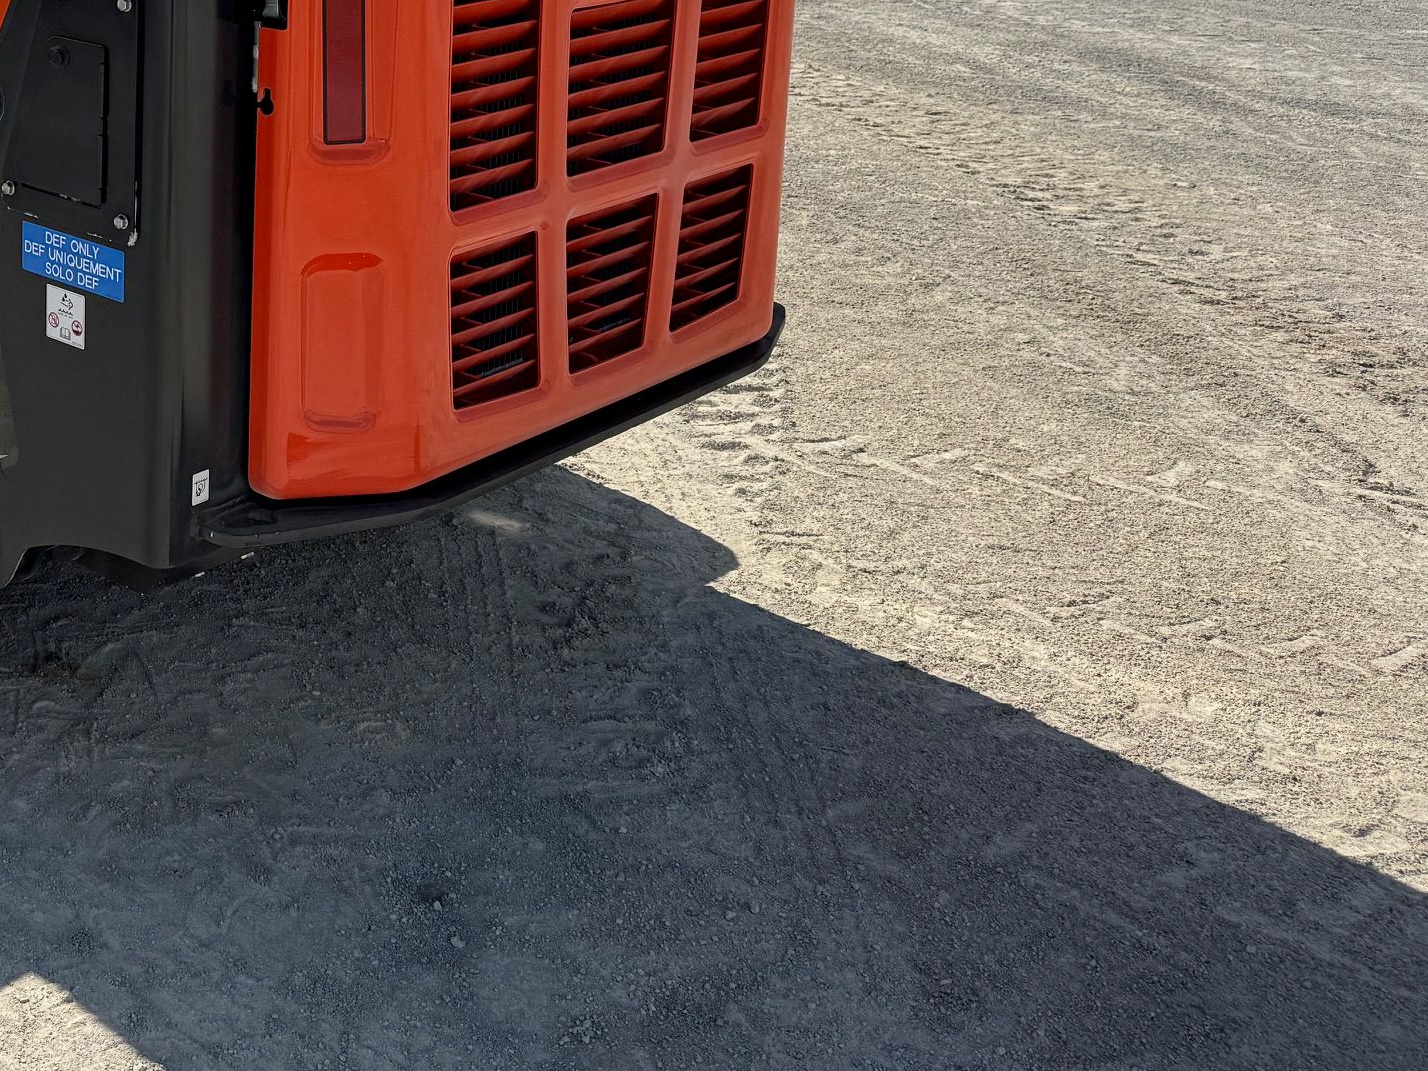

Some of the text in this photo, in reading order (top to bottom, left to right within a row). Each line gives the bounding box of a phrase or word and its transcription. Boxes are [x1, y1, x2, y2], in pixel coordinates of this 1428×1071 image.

[45, 231, 100, 260] DEF ONLY
[24, 239, 122, 282] DEF UNIQUEMENT
[45, 262, 99, 290] SOLO DEF
